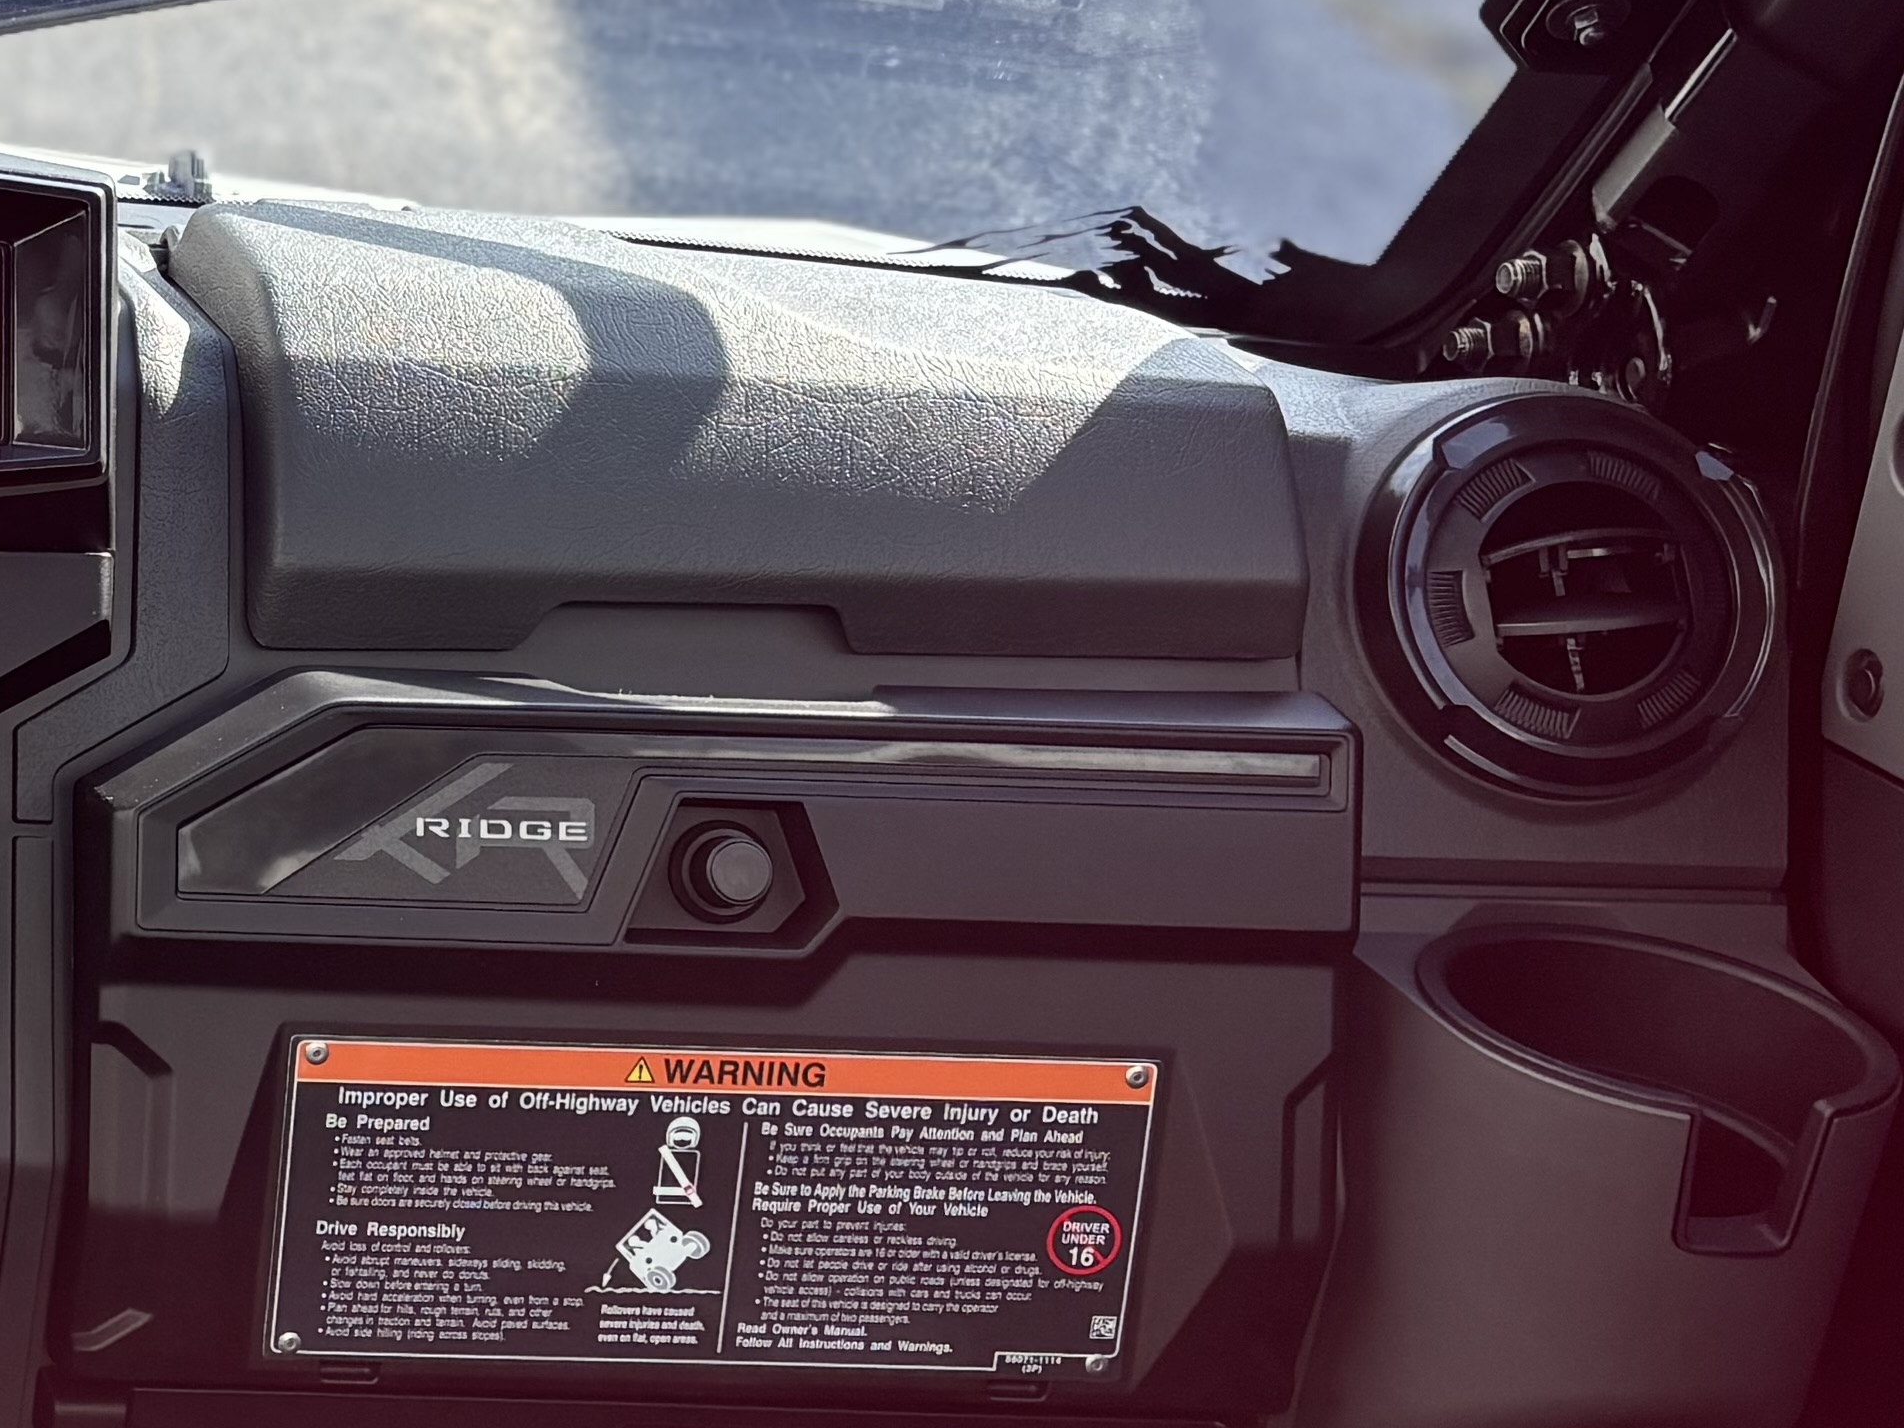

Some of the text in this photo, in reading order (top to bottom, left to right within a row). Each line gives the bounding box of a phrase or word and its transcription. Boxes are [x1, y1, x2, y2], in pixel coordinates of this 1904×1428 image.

[415, 817, 588, 842] RIDGE
[664, 1057, 827, 1088] WARNING
[338, 1086, 1098, 1125] Improper Use of Off-Highway Vehicles Can Cause Severe Injury or Death
[325, 1113, 430, 1133] Be Prepared
[761, 1121, 778, 1135] Be
[784, 1121, 813, 1136] Sure
[890, 1125, 913, 1142] Pay
[919, 1126, 974, 1140] Attention
[980, 1128, 1004, 1141] and
[1010, 1128, 1037, 1142] Plan
[1043, 1129, 1083, 1143] Ahead
[753, 1181, 1096, 1206] Be Sure to Apply the Parking Brake Before Leaving the Vehicle.
[751, 1197, 988, 1217] Require Proper Use of Your Vehicle
[315, 1219, 465, 1241] Drive Responsibly
[1062, 1220, 1110, 1235] DRIVER
[1061, 1233, 1106, 1246] UNDER
[1068, 1248, 1095, 1267] 16
[736, 1322, 867, 1336] Read Owner's Manual.
[735, 1335, 952, 1355] Follow All Instructions and Warnings.
